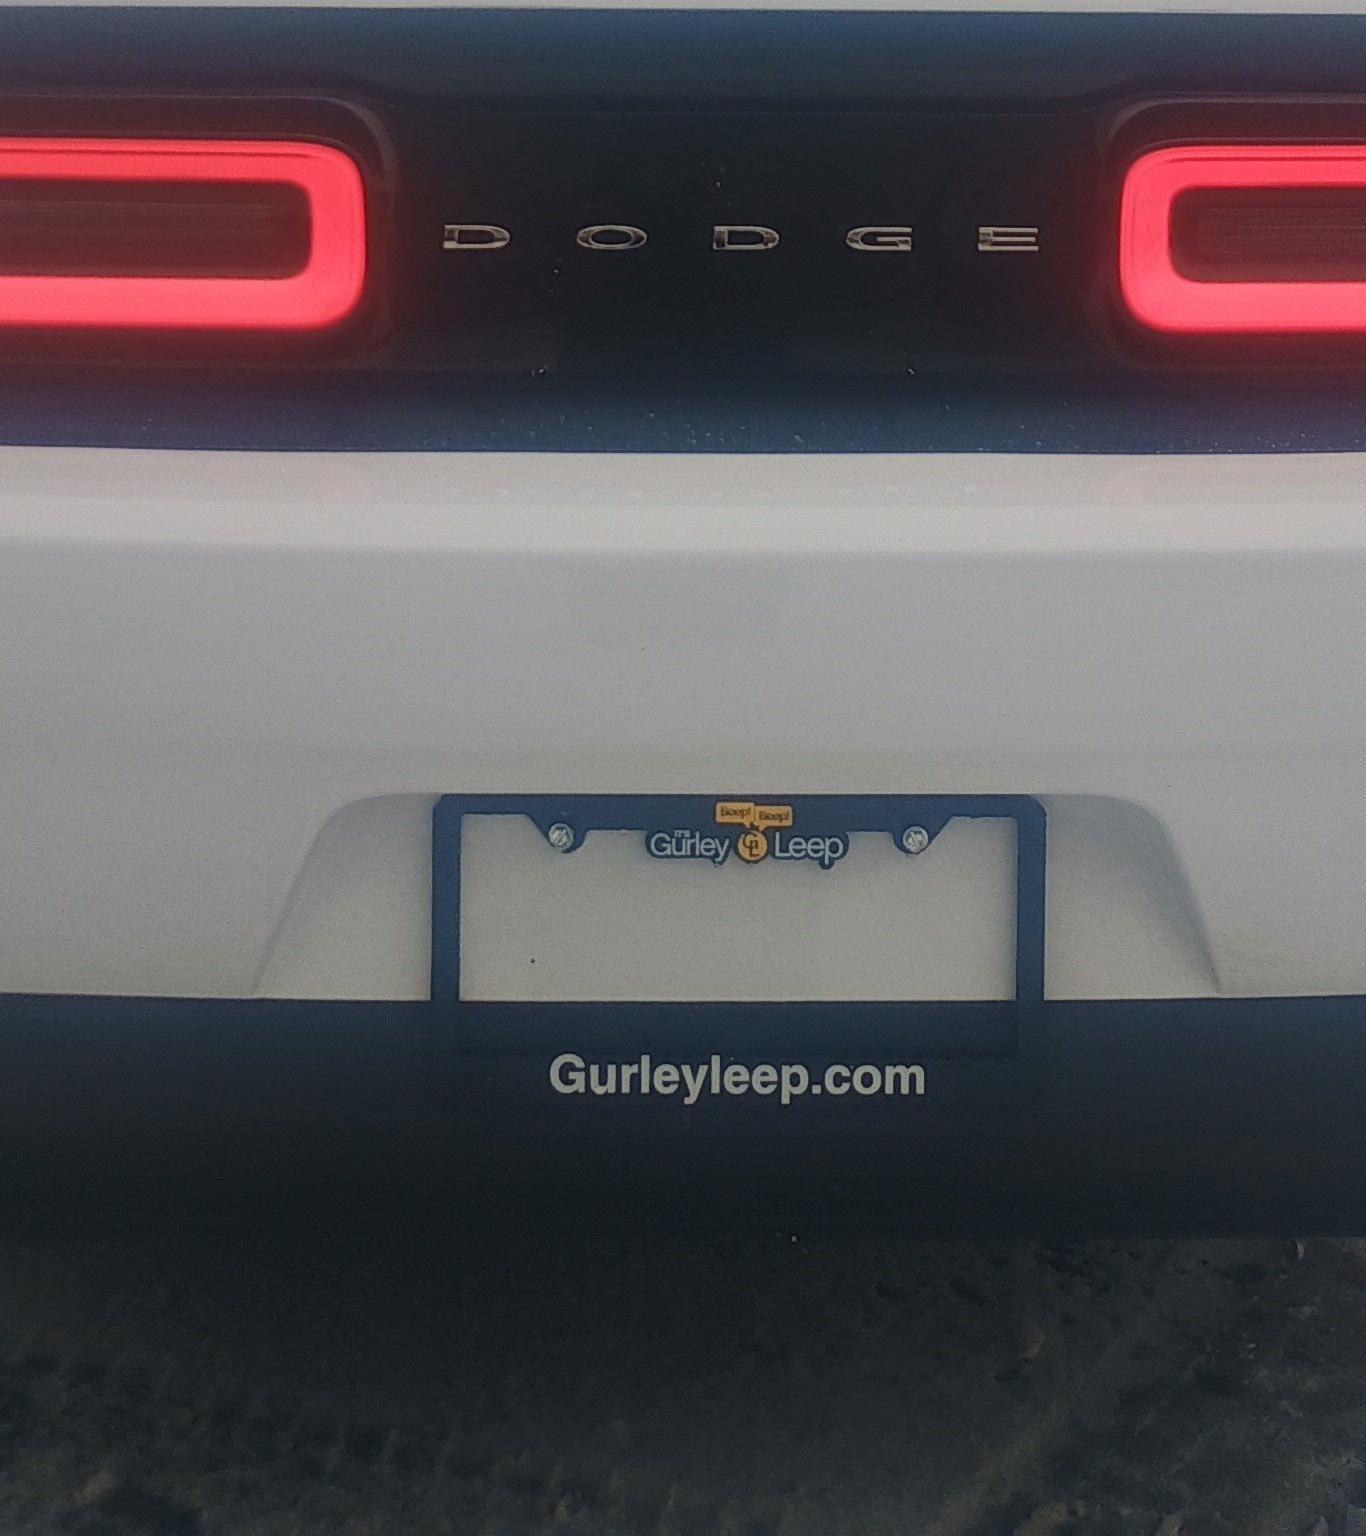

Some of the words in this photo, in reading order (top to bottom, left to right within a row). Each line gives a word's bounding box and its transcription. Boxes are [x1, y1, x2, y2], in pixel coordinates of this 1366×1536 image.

[442, 223, 1040, 253] DODGE
[774, 831, 844, 865] Leep
[548, 1052, 927, 1106] Gurleyleep.com
